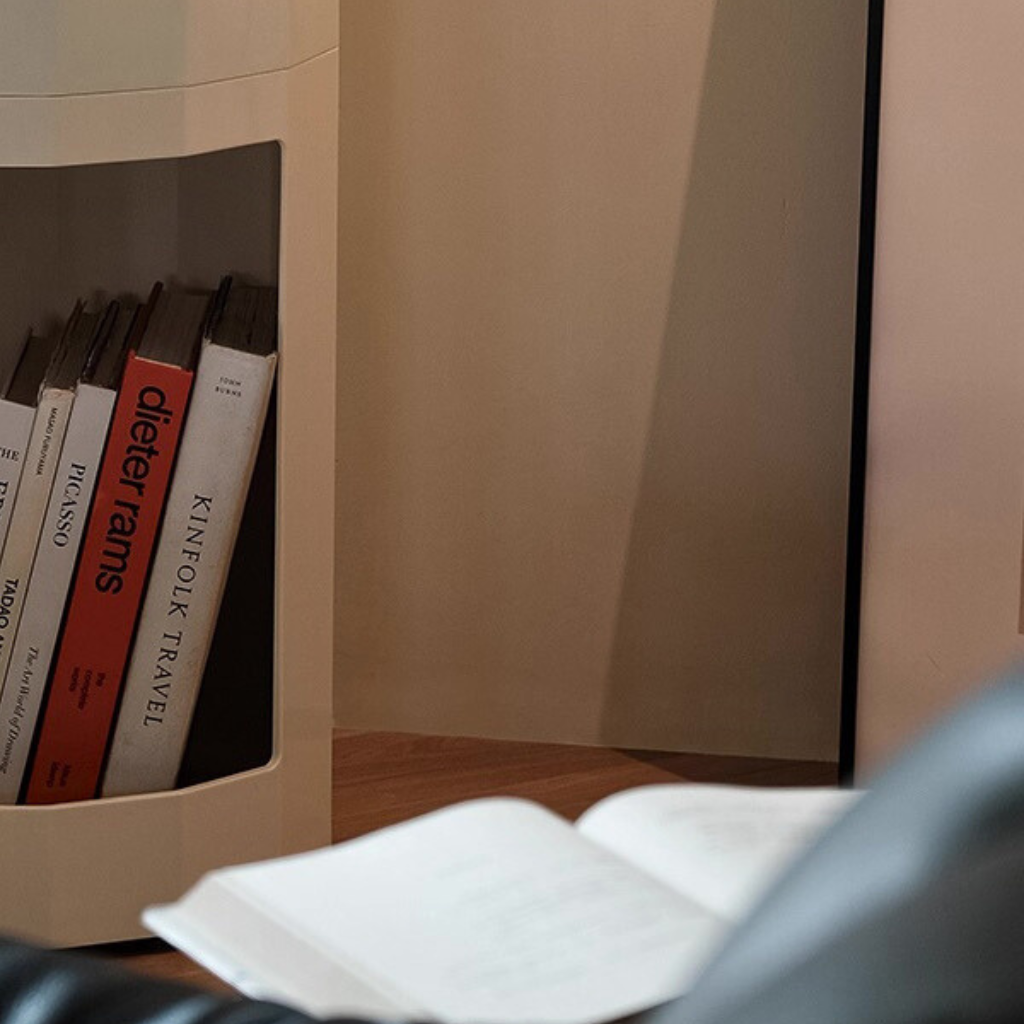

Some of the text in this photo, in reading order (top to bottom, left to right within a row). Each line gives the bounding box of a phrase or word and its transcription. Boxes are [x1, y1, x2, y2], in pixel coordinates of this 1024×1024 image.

[52, 463, 86, 548] PICASSO
[95, 385, 173, 595] dieter rams
[143, 494, 213, 727] KINFOLK TRAVEL
[26, 646, 39, 664] The
[8, 716, 21, 732] of
[15, 685, 30, 718] World
